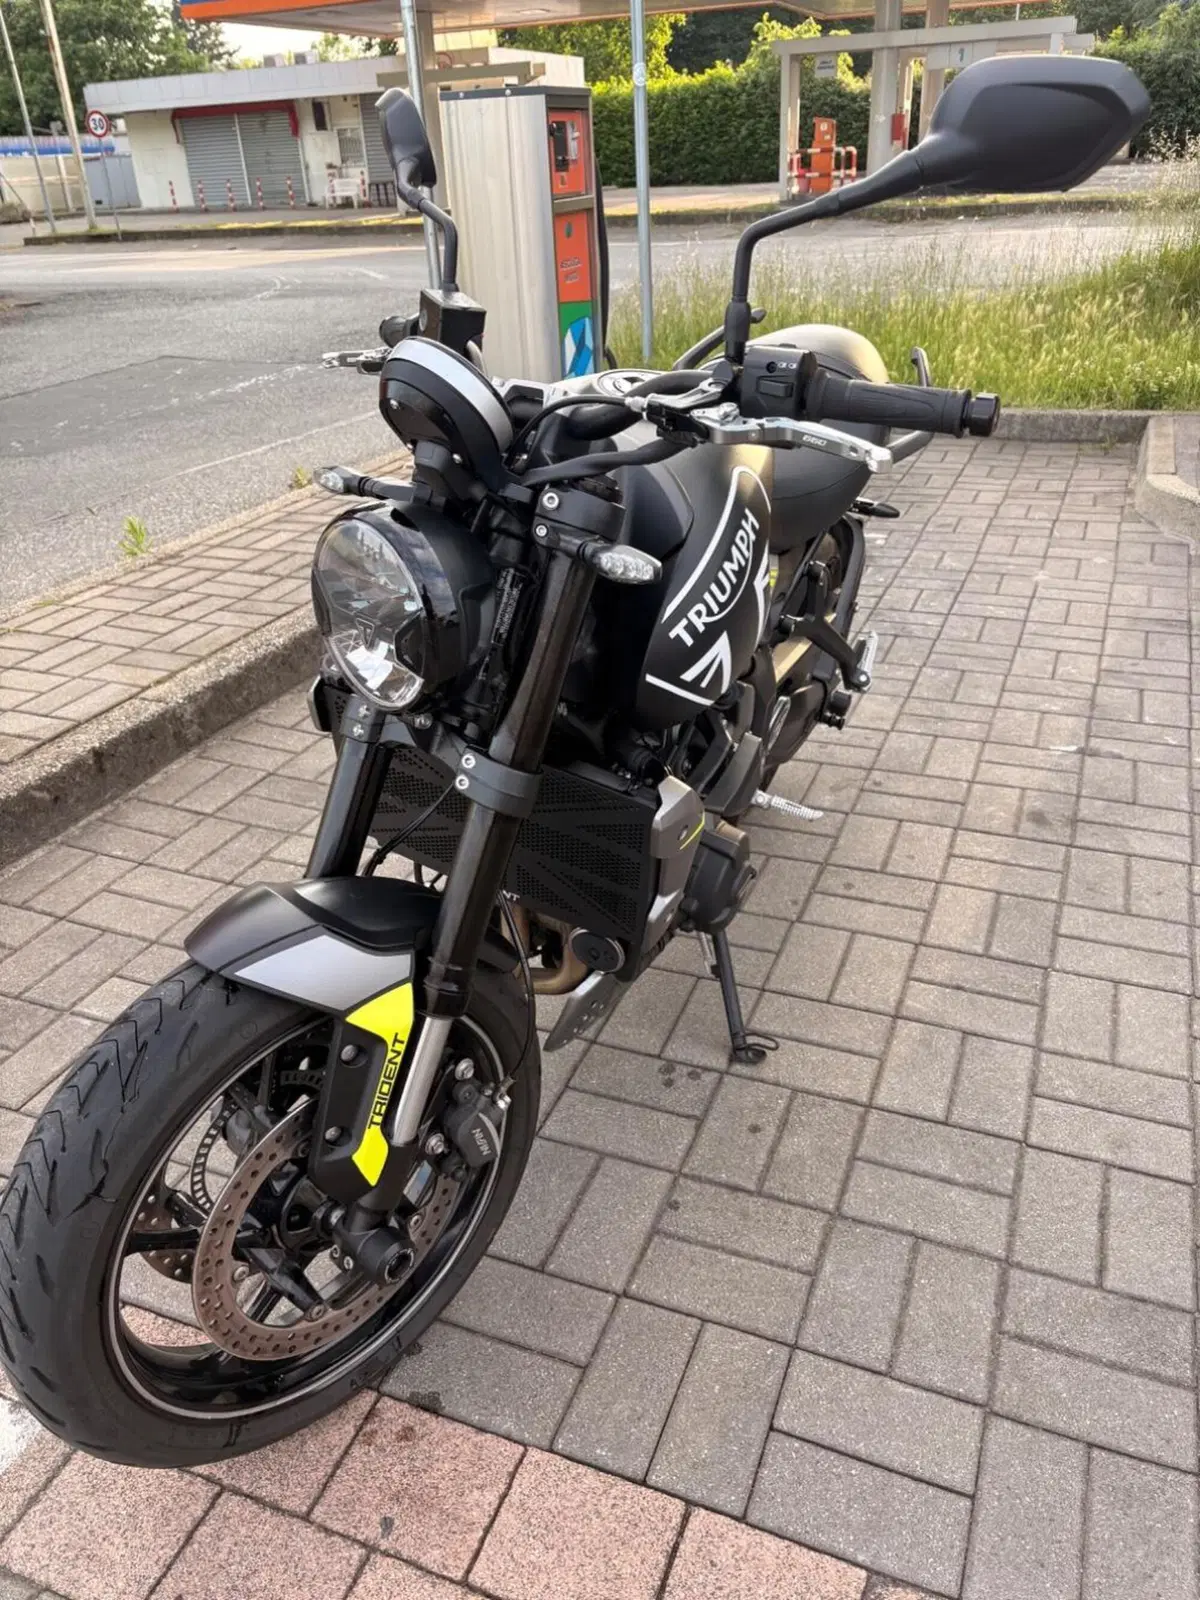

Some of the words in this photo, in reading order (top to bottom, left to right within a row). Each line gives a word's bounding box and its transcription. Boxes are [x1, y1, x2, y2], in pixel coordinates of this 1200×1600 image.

[91, 117, 105, 131] 30
[668, 507, 760, 647] TRIUMPH
[367, 1032, 405, 1129] TRIDENT
